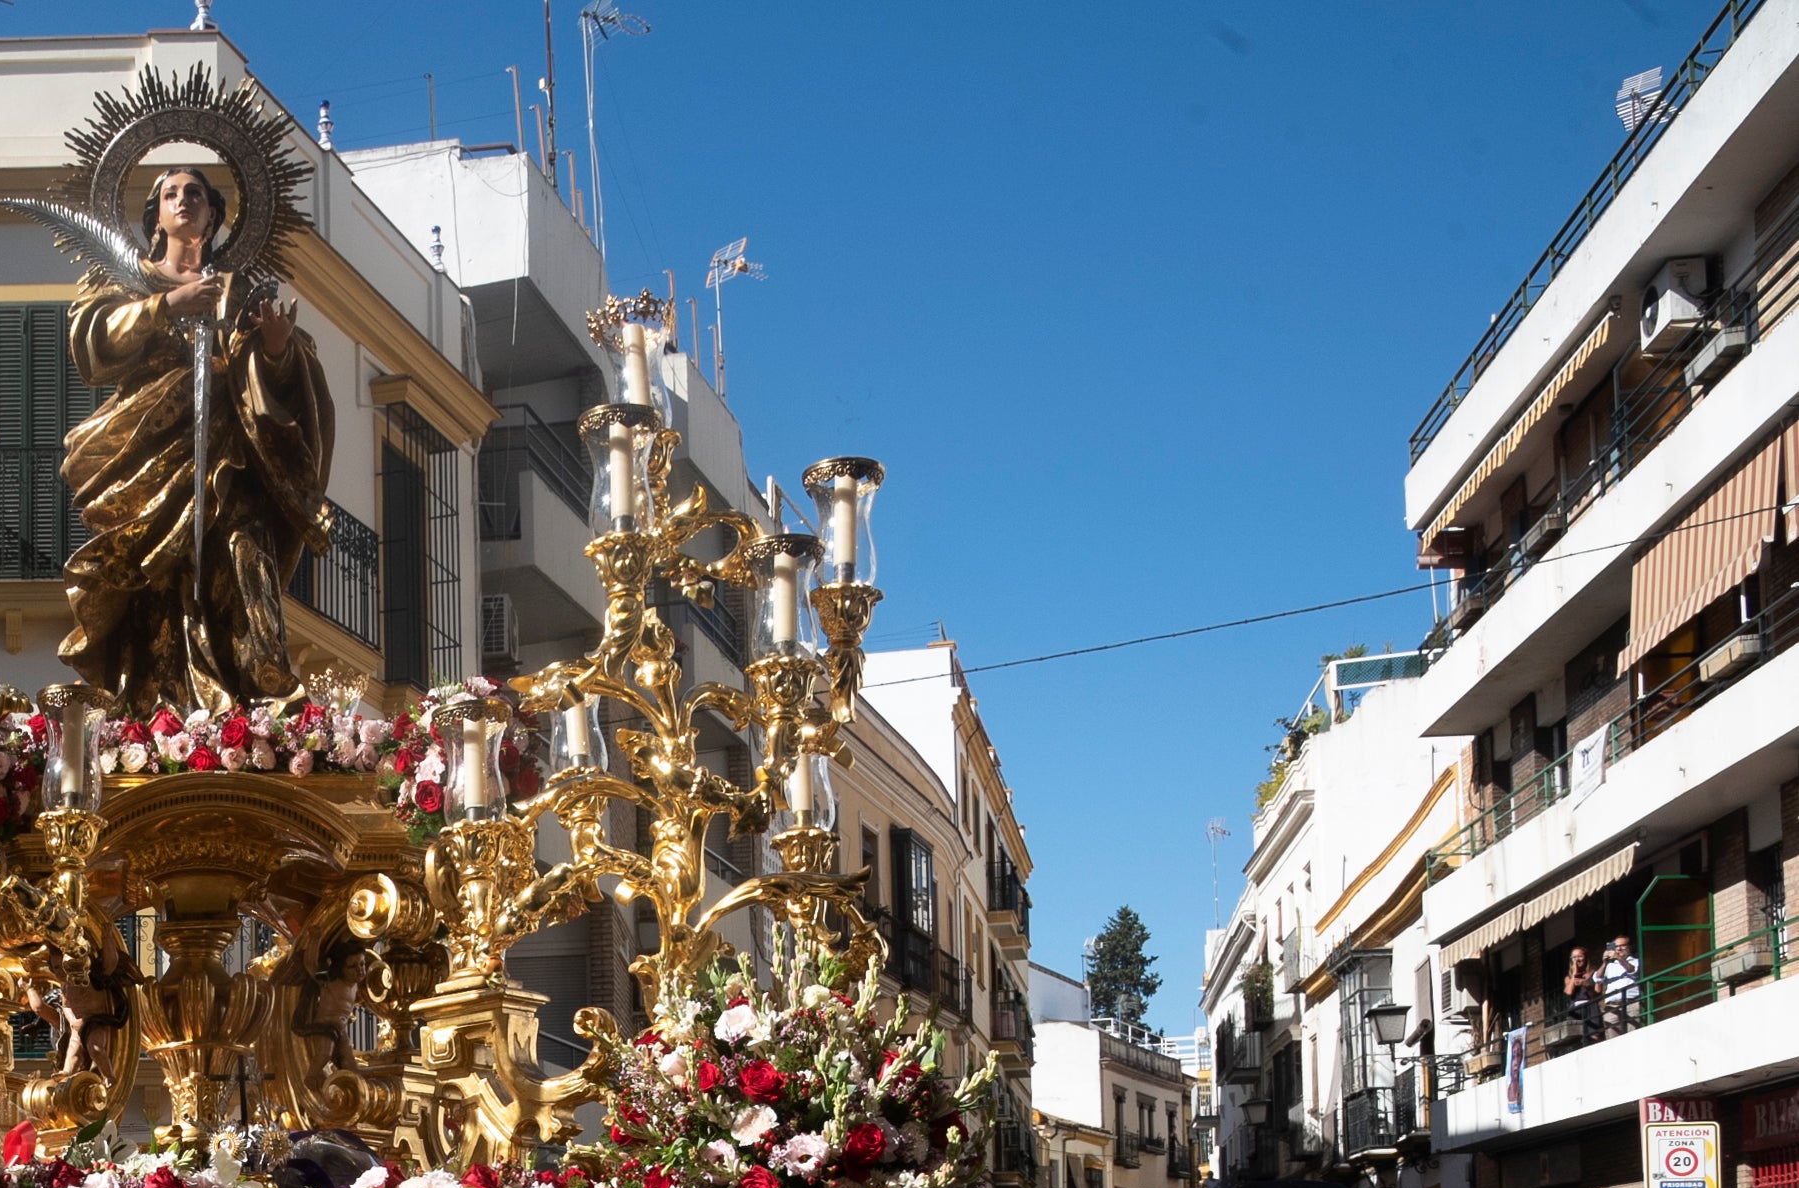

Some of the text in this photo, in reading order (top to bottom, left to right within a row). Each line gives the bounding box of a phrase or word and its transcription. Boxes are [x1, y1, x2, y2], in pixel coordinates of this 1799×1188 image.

[1647, 1100, 1714, 1122] BAZAR
[1655, 1129, 1710, 1137] ATENCIÓN
[1673, 1156, 1692, 1167] 20
